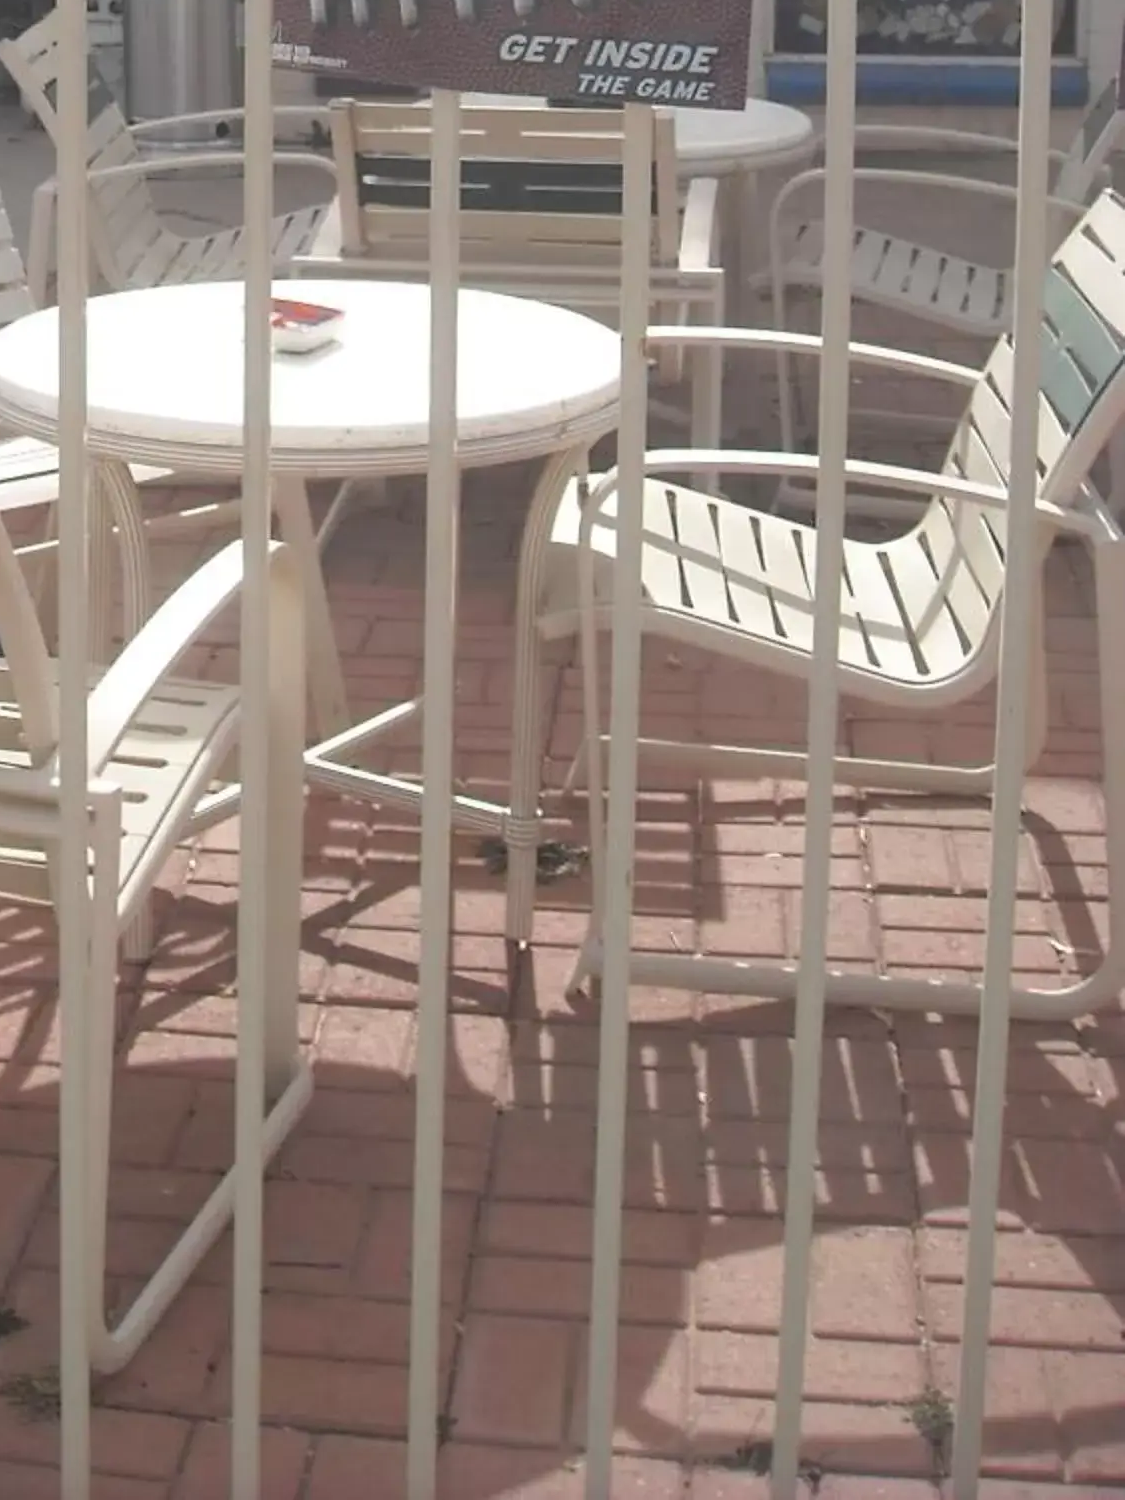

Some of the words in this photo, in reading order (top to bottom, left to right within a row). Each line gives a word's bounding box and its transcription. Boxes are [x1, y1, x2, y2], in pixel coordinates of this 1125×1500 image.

[499, 34, 579, 64] GET
[584, 39, 719, 74] INSIDE
[578, 73, 631, 96] THE
[636, 77, 716, 101] GAME
